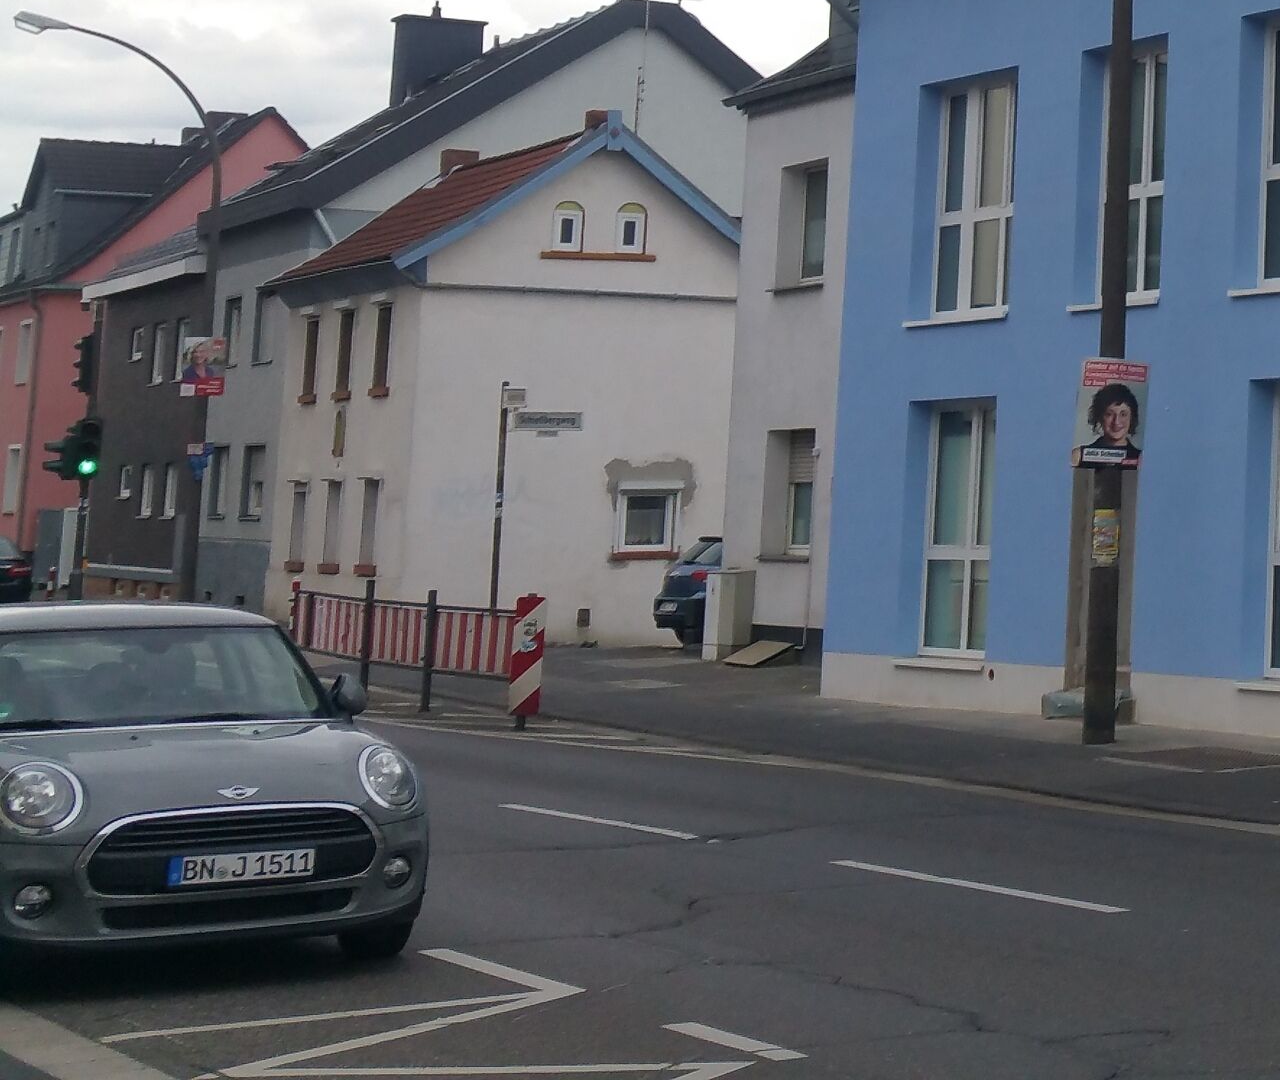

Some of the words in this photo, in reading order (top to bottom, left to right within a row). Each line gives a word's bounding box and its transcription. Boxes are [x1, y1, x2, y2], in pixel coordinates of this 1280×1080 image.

[182, 858, 215, 881] BN
[232, 856, 247, 877] J
[253, 852, 311, 876] 1511
